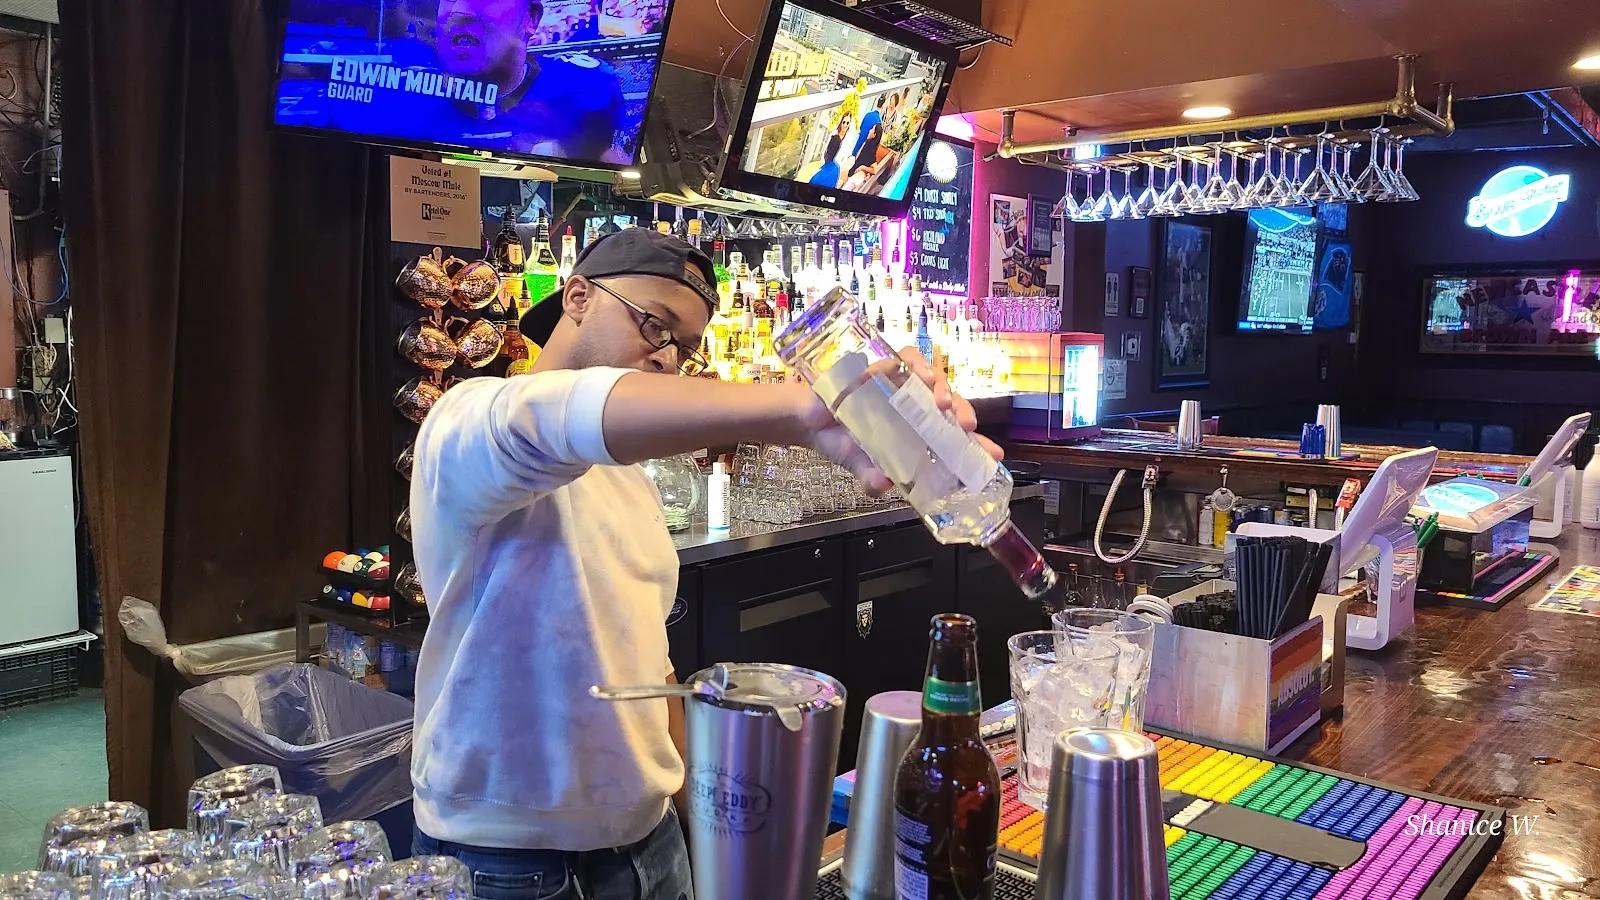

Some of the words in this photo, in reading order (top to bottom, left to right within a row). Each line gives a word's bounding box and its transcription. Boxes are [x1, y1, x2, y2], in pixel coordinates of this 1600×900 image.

[331, 57, 401, 90] EDWIN
[405, 69, 498, 105] MULITALO
[327, 82, 374, 104] GUARD
[421, 165, 442, 177] Voted
[443, 170, 452, 178] #1
[411, 175, 441, 188] Moscow
[442, 179, 461, 191] Mule
[413, 188, 452, 199] BARTENDERS,
[913, 187, 923, 201] $4
[439, 207, 451, 216] One
[912, 206, 922, 220] $4
[911, 226, 921, 242] $6
[909, 250, 919, 265] $3
[1438, 314, 1457, 323] The
[723, 791, 763, 812] EDDY
